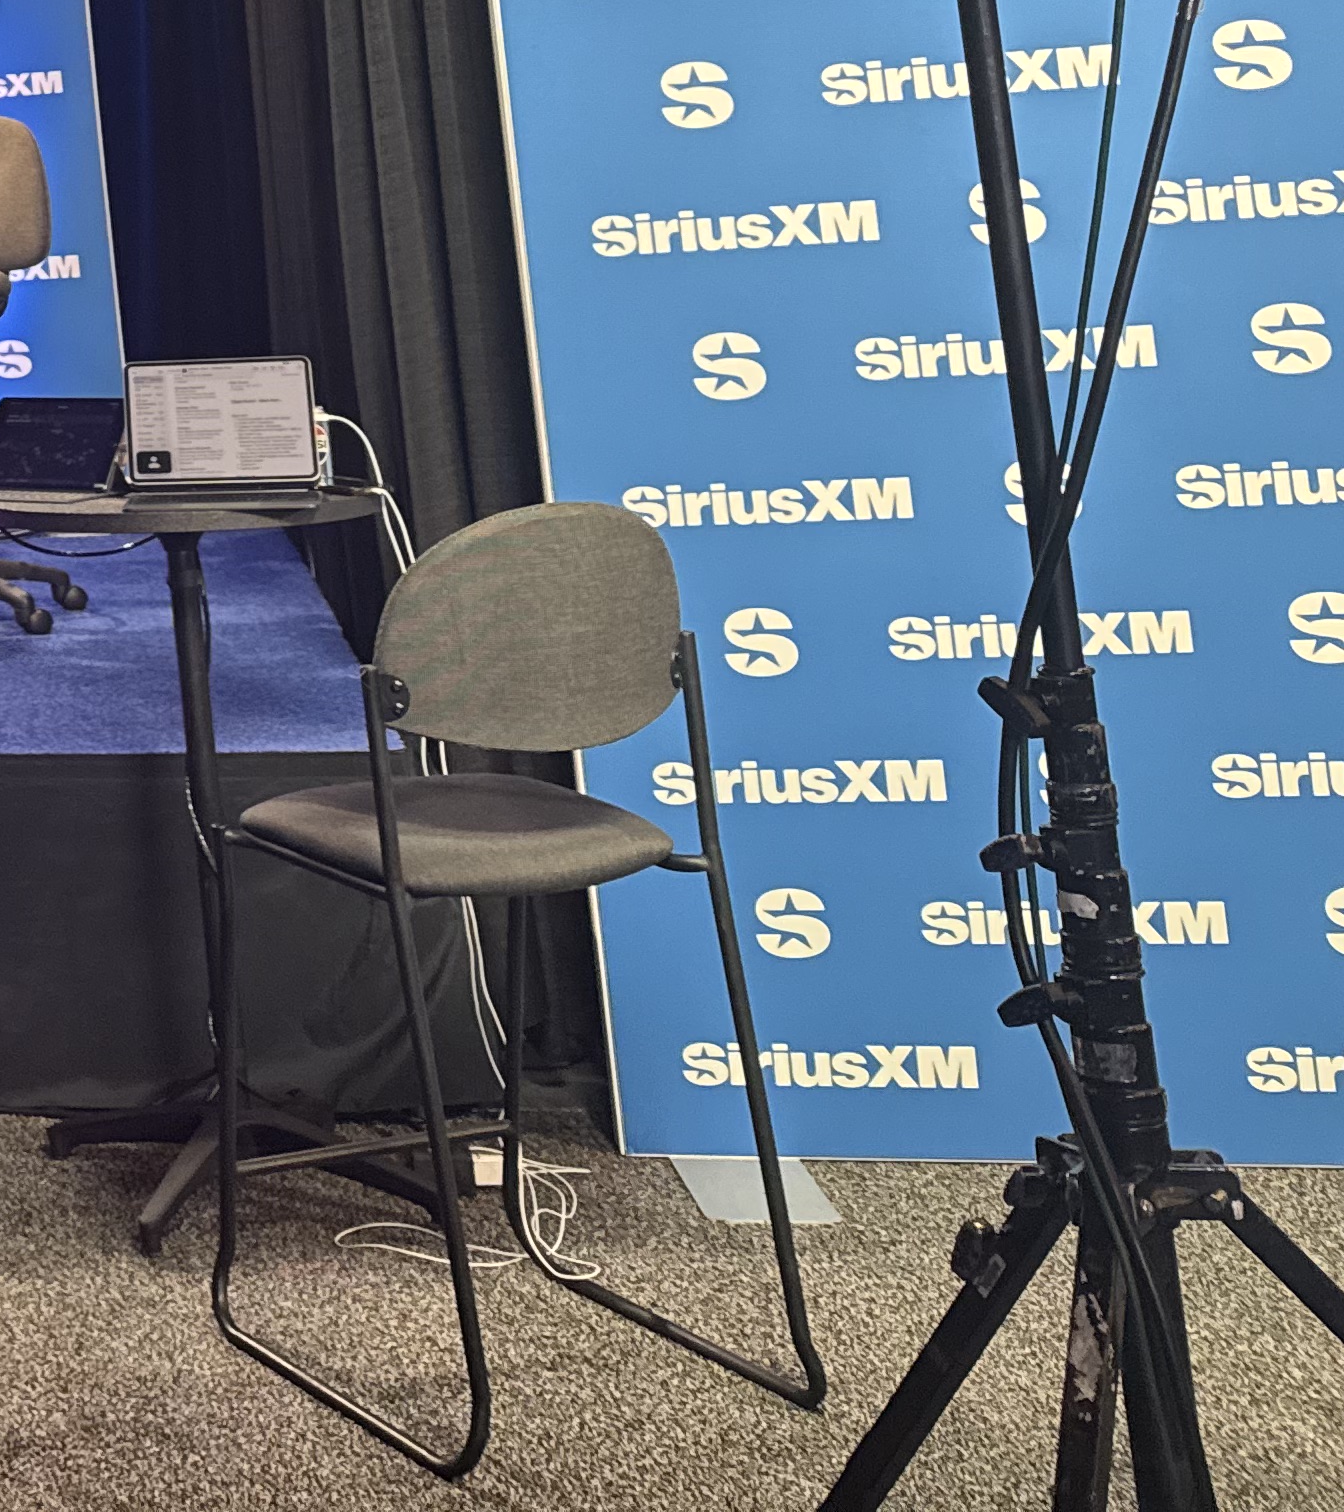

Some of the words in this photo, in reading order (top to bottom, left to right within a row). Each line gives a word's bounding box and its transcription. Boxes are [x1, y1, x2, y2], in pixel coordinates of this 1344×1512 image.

[821, 43, 1121, 106] SiriuXM
[592, 199, 880, 258] SiriusXM
[1148, 170, 1344, 228] Sirius
[855, 324, 1159, 381] SiriuXM
[622, 476, 914, 528] SiriusXM
[888, 610, 1195, 661] SiriuXM
[652, 759, 948, 806] SriusXM
